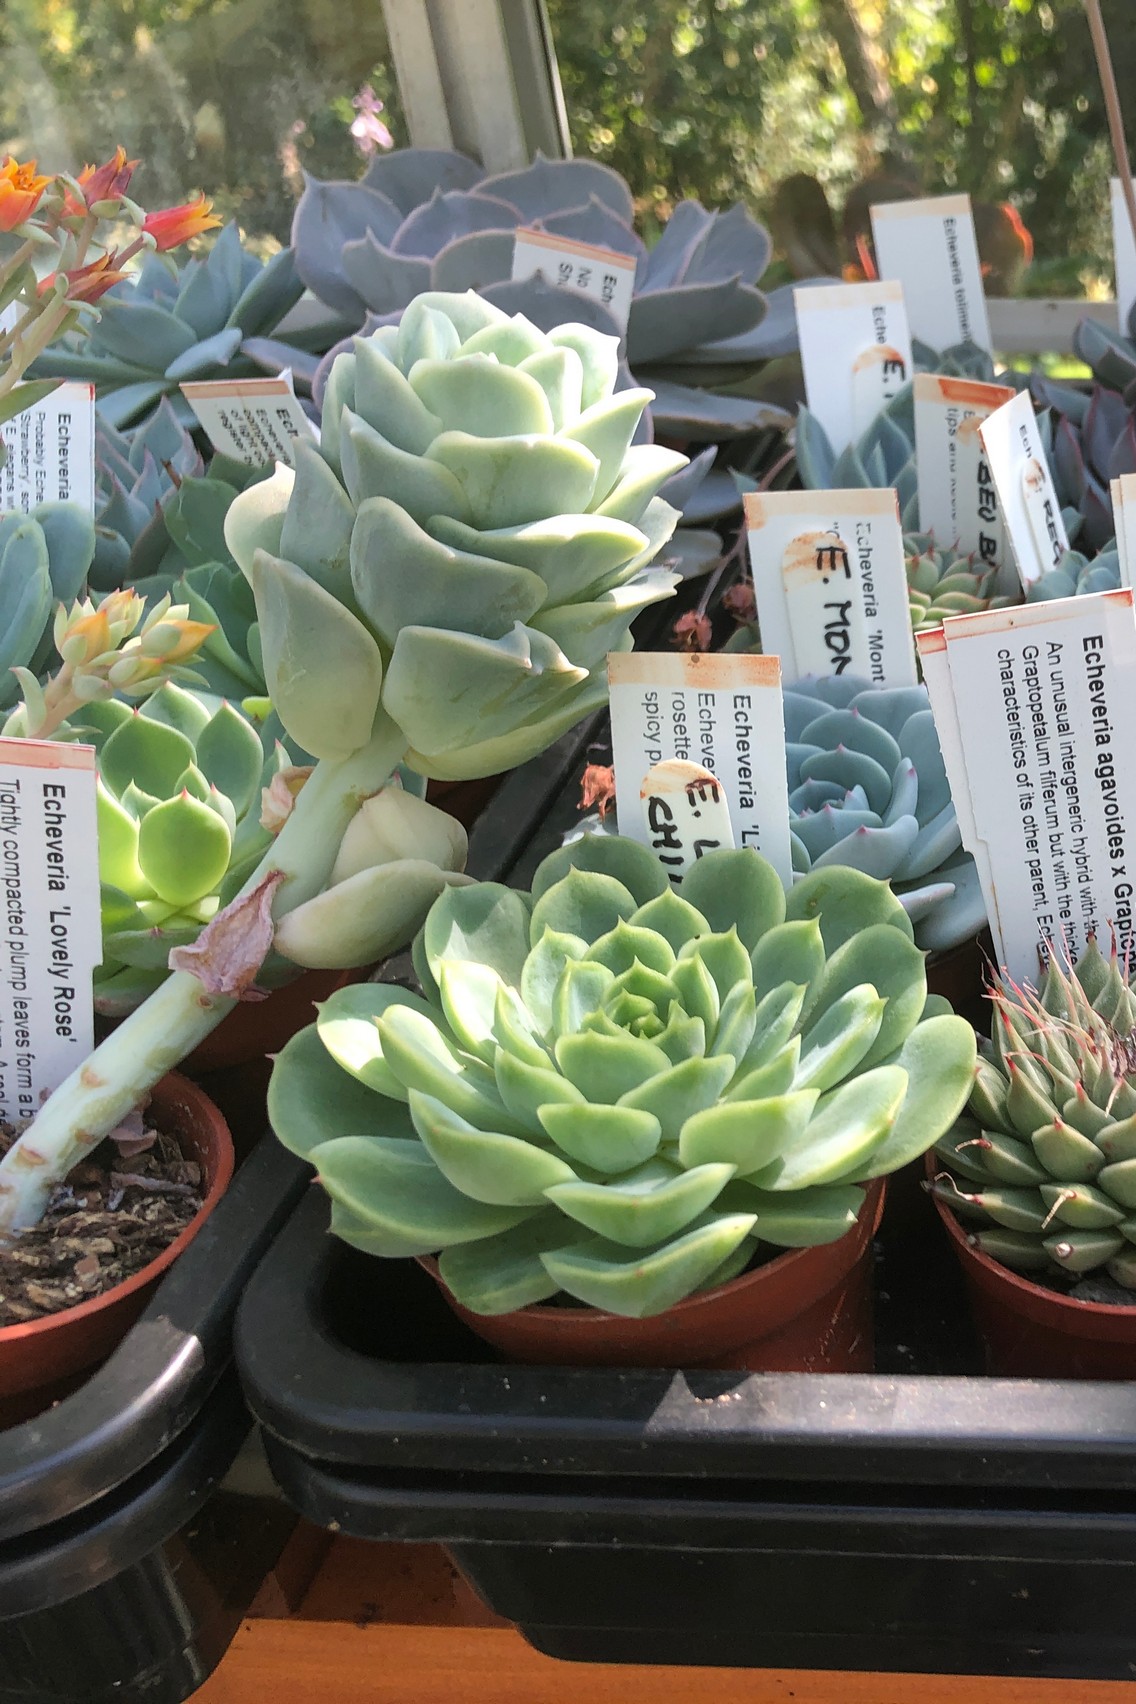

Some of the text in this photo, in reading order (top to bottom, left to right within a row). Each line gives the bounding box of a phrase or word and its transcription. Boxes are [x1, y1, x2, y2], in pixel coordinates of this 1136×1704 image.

[58, 413, 71, 500] Echeveria
[816, 546, 851, 584] E.
[1046, 641, 1064, 664] An
[997, 648, 1028, 769] characteristics
[1022, 645, 1053, 767] Graptopetalum
[1051, 670, 1072, 737] unusual
[1083, 634, 1114, 746] Echeveria
[641, 692, 663, 742] spicy
[733, 694, 756, 809] Echeveria
[0, 778, 22, 834] Tightly
[684, 778, 720, 818] E.
[1016, 773, 1033, 789] of
[1019, 793, 1036, 811] its
[1040, 770, 1060, 830] filferum
[1059, 741, 1085, 833] intergeneric
[1095, 753, 1127, 860] agavoides
[1022, 815, 1041, 855] other
[1050, 832, 1064, 859] but
[1026, 860, 1048, 911] parent,
[1053, 860, 1070, 892] with
[1069, 838, 1092, 883] hybrid
[1111, 866, 1127, 877] x
[2, 839, 30, 935] compacted
[1058, 895, 1073, 919] the
[1080, 887, 1097, 917] with
[43, 783, 77, 1042] Echeveria 'Lovely Rose'
[9, 941, 32, 991] plump
[12, 996, 34, 1048] leaves
[17, 1052, 35, 1088] form
[19, 1093, 35, 1104] a
